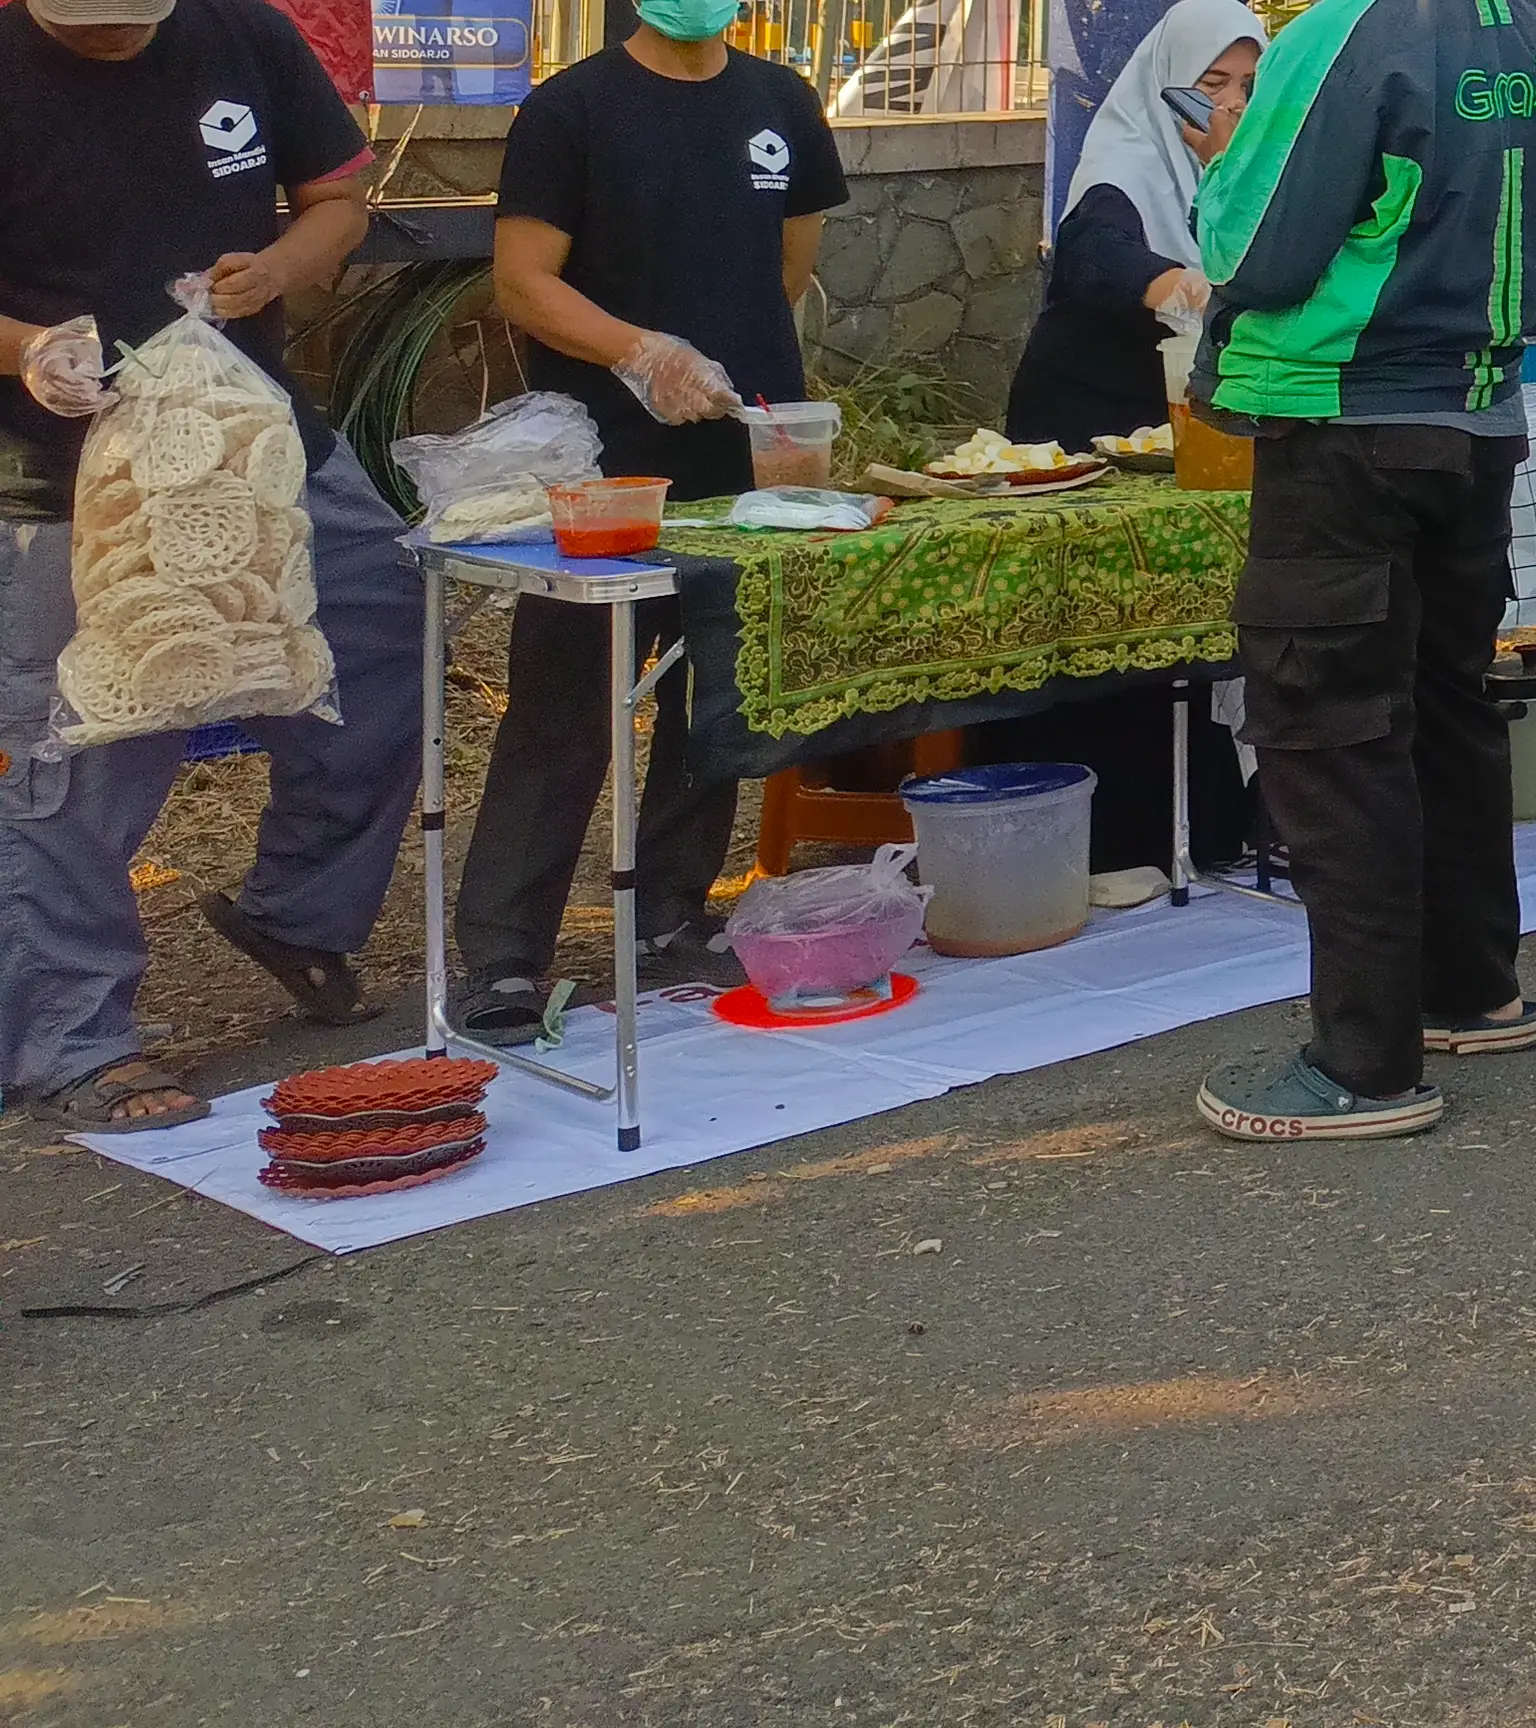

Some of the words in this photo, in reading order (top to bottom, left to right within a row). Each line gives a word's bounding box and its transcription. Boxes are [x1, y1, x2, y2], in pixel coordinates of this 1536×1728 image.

[374, 26, 499, 47] WINARSO
[391, 48, 450, 59] SIDOARJO
[212, 154, 267, 178] SIDOARJO
[1220, 1108, 1304, 1138] crocs
